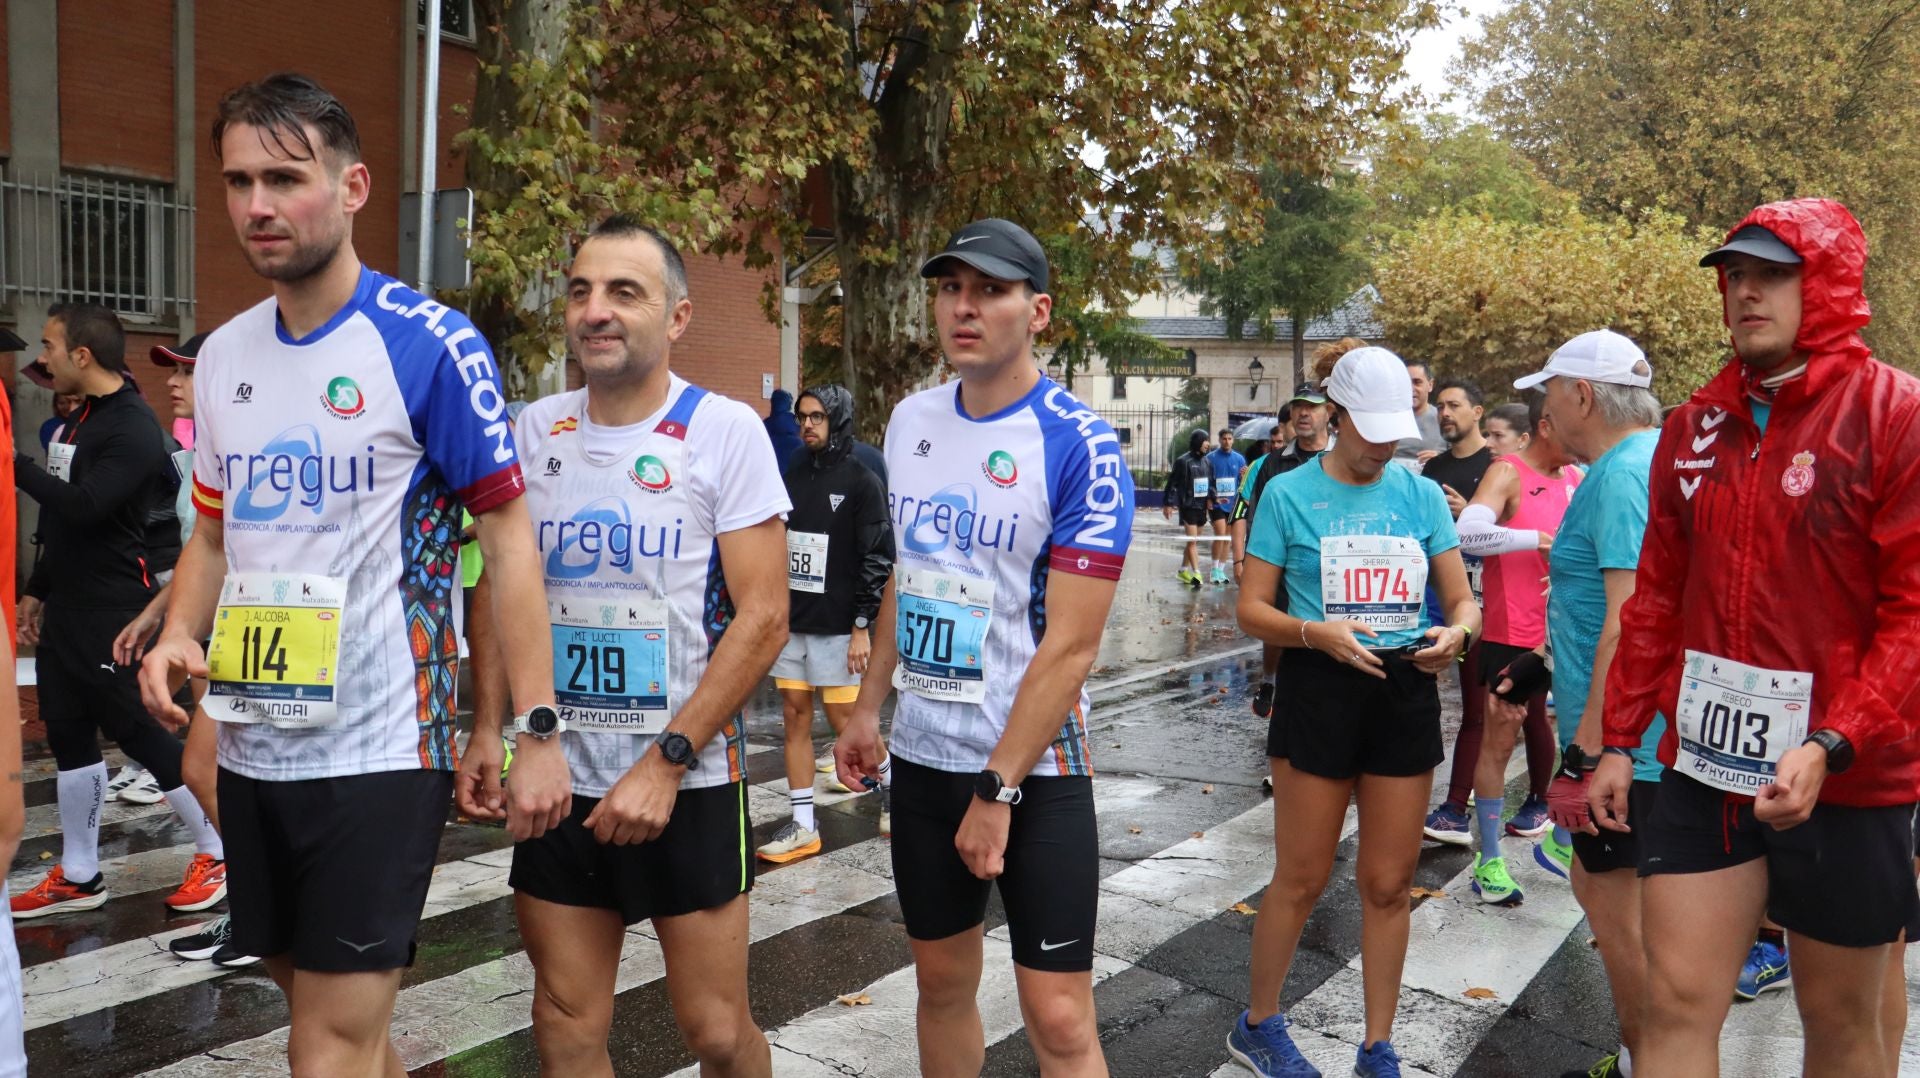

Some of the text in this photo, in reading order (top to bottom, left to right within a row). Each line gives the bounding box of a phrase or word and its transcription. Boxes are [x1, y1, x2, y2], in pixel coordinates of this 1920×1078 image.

[1673, 456, 1716, 470] hummel
[539, 519, 683, 568] rregui
[1362, 558, 1391, 566] SHERPA
[1343, 568, 1410, 603] 1074
[1364, 615, 1409, 624] HYUNDAI
[904, 611, 956, 664] 570
[242, 626, 289, 681] 114
[567, 643, 626, 694] 219
[908, 675, 962, 692] HYUNDAI
[1721, 690, 1752, 708] REBECO
[580, 710, 644, 724] HYUNDAI
[1700, 700, 1770, 759] 1013
